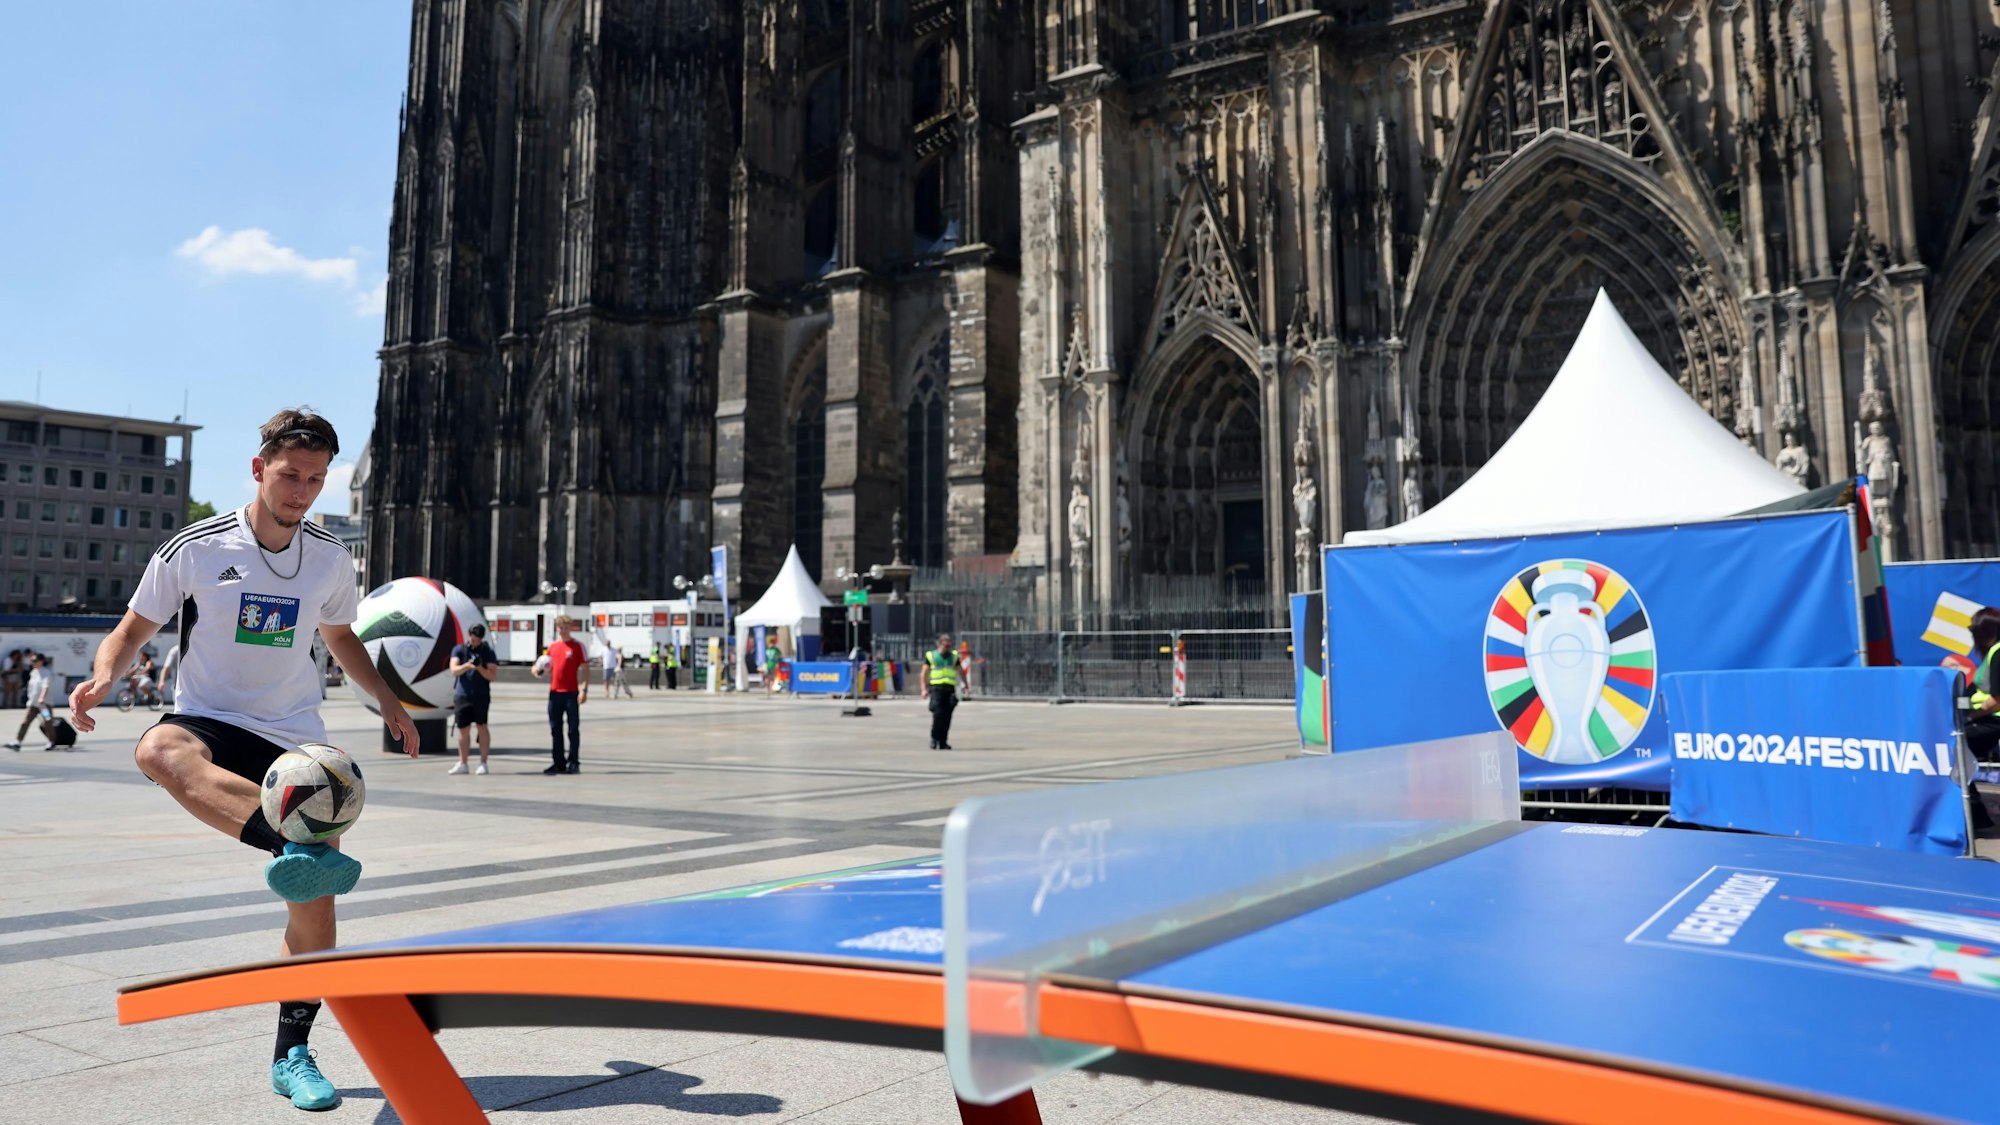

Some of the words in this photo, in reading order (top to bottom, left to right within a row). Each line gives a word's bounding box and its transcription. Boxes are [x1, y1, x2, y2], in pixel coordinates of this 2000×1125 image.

[799, 672, 840, 682] COLOGNE
[1634, 747, 1652, 758] TM
[1674, 732, 1736, 761] EURO
[1736, 733, 1803, 766] 2024
[1804, 736, 1953, 777] FESTIVAL
